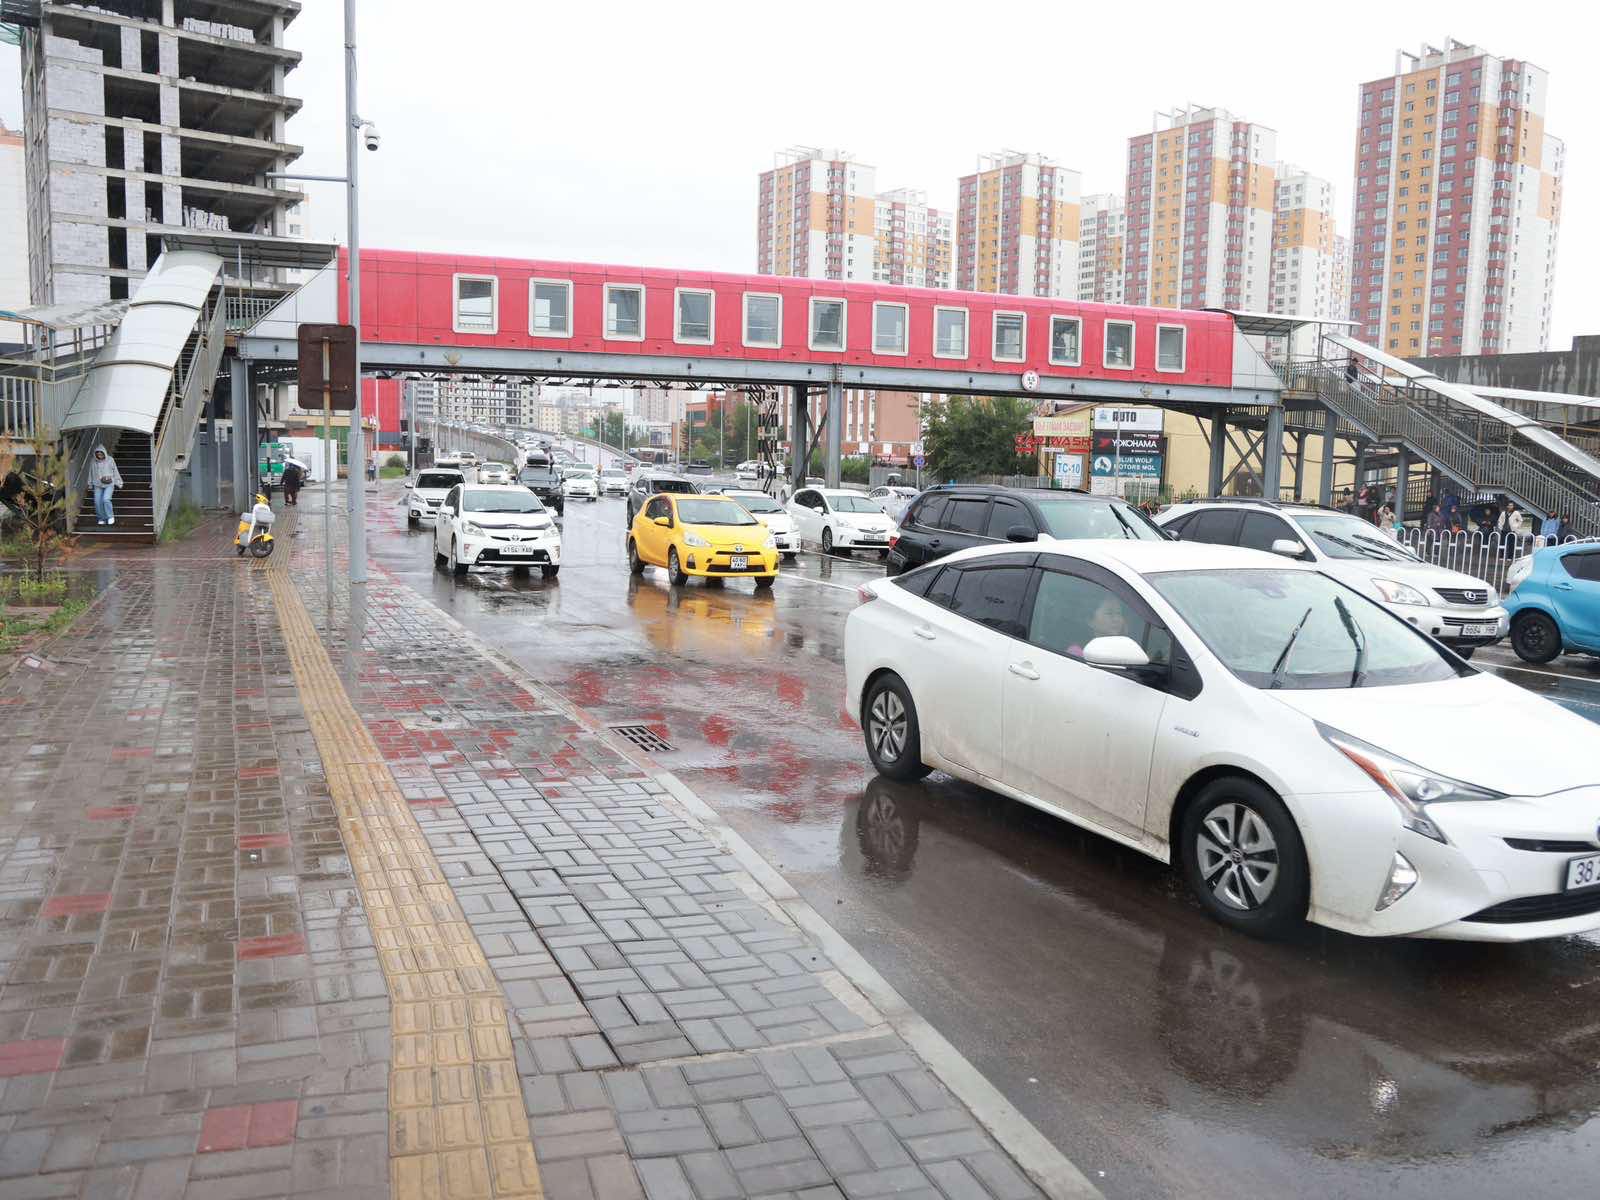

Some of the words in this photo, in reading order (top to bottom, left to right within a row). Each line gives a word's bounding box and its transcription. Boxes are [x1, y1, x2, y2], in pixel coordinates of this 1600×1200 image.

[1112, 411, 1137, 423] AUTO
[1049, 436, 1092, 448] WASH
[1111, 439, 1157, 448] YOKOHAMA
[1575, 860, 1600, 885] 38
